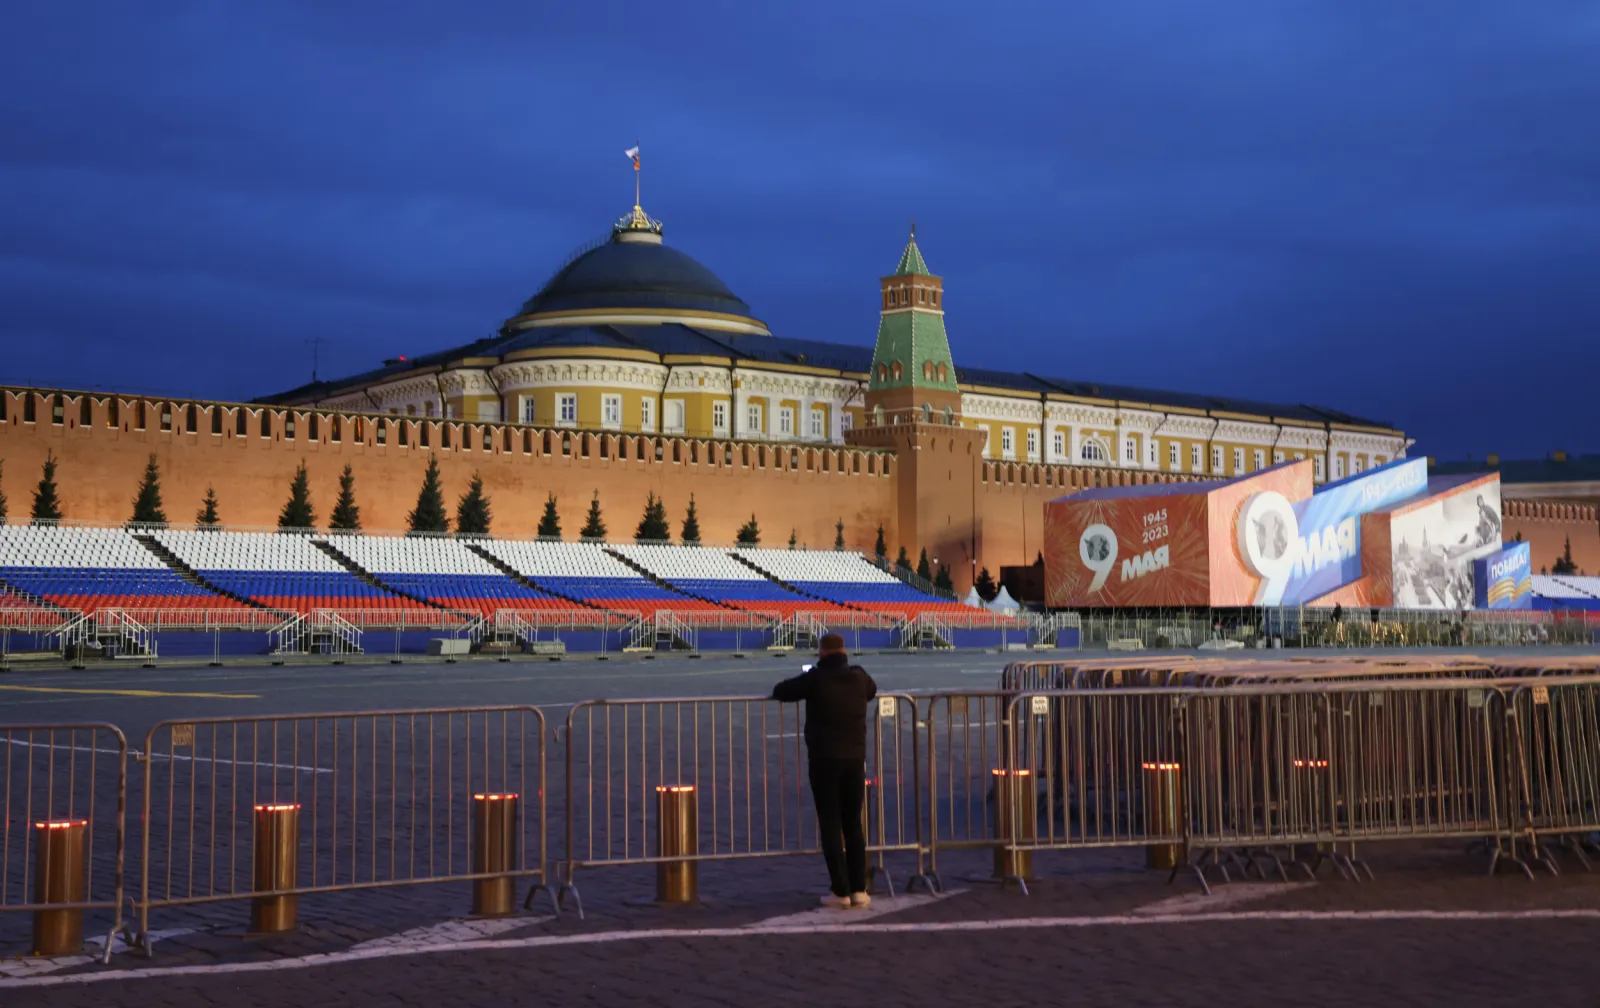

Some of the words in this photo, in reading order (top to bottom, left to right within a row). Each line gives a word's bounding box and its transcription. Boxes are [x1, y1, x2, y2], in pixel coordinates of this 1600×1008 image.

[1142, 508, 1167, 527] 1945
[1142, 524, 1169, 544] 2023
[1244, 490, 1298, 606] 9
[1294, 515, 1356, 580] МАЯ
[1079, 523, 1118, 595] 9
[1121, 544, 1170, 582] МАЯ
[1491, 552, 1528, 580] ПОБЕДА!
